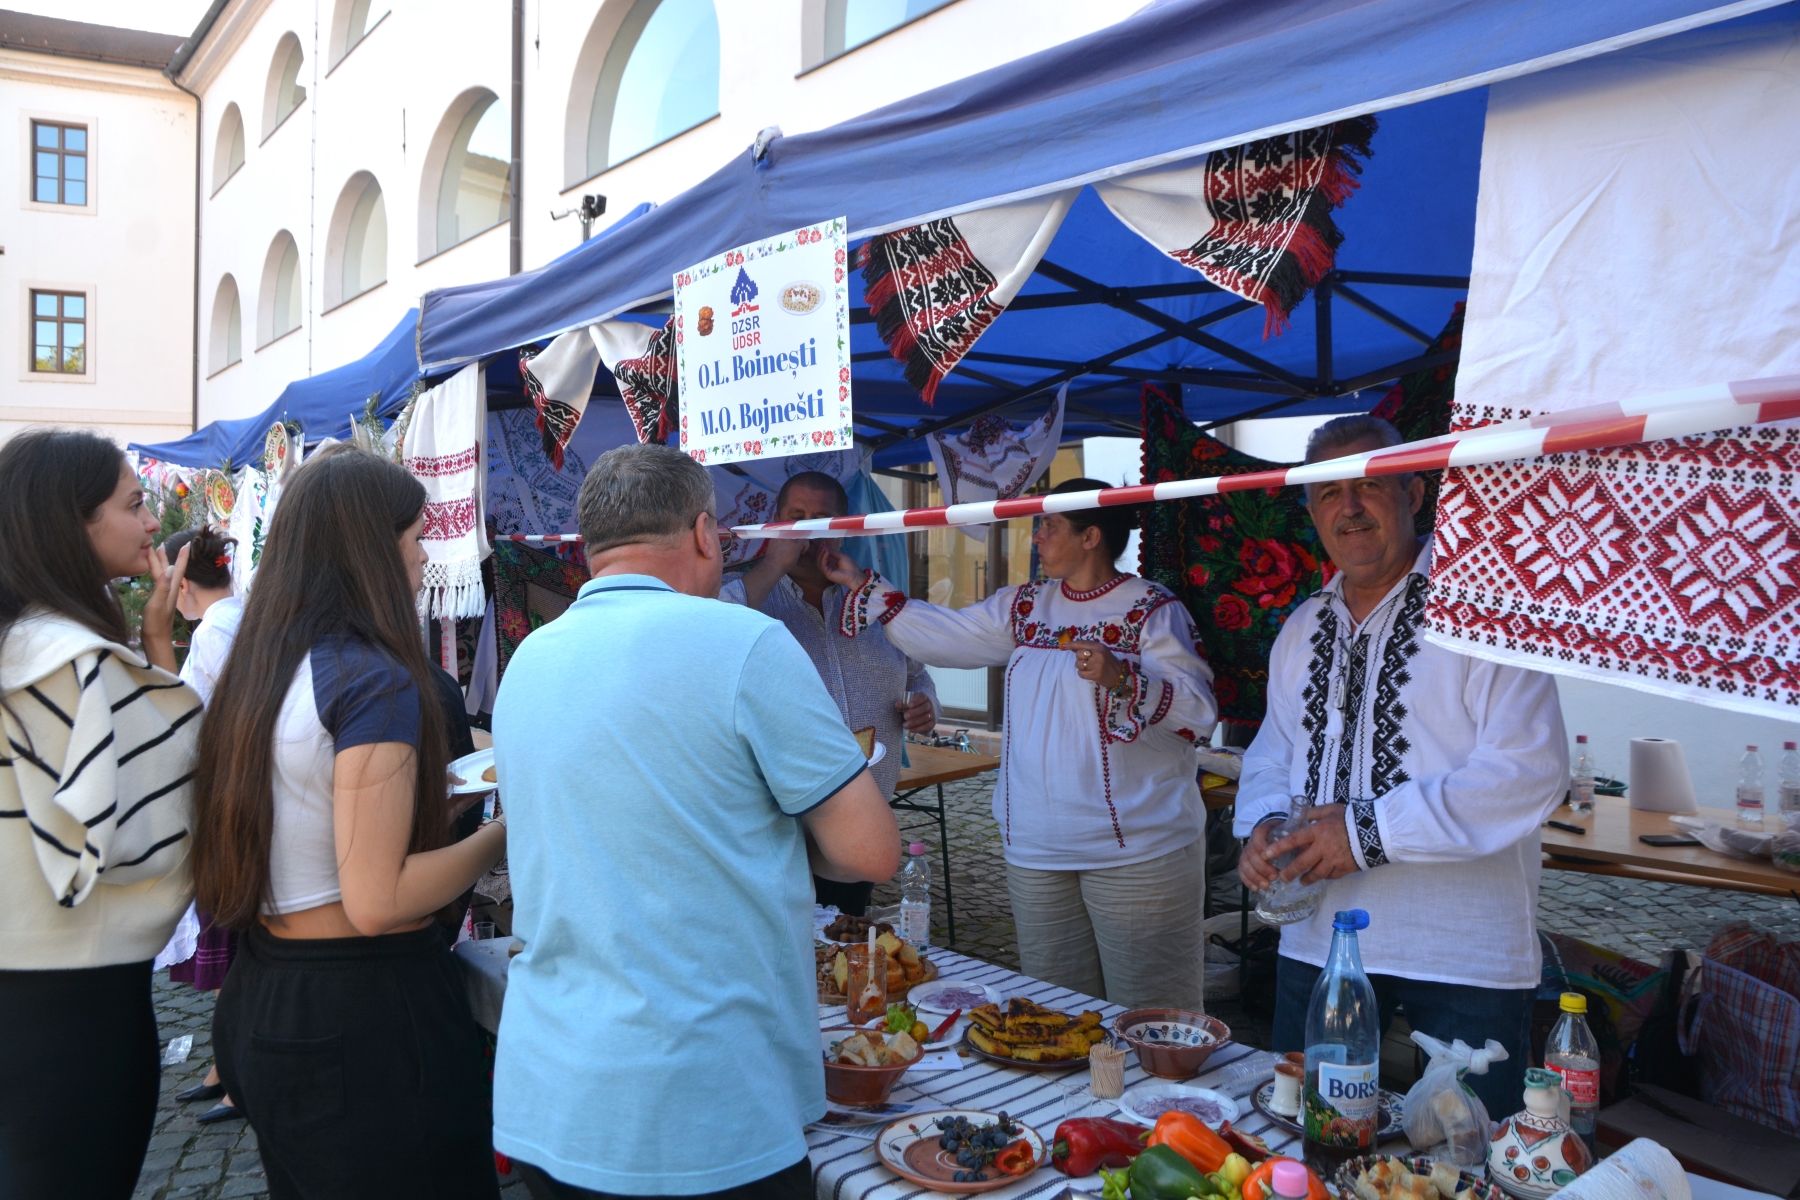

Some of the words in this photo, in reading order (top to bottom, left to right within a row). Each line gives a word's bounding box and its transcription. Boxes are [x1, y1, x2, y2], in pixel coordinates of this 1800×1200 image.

[731, 315, 760, 335] DZSR
[732, 331, 761, 351] UDSR
[698, 360, 729, 389] O.L.
[732, 337, 818, 382] Boinești
[700, 406, 736, 436] M.O.
[739, 388, 825, 435] Bojnešti
[1328, 1077, 1378, 1099] BORS
